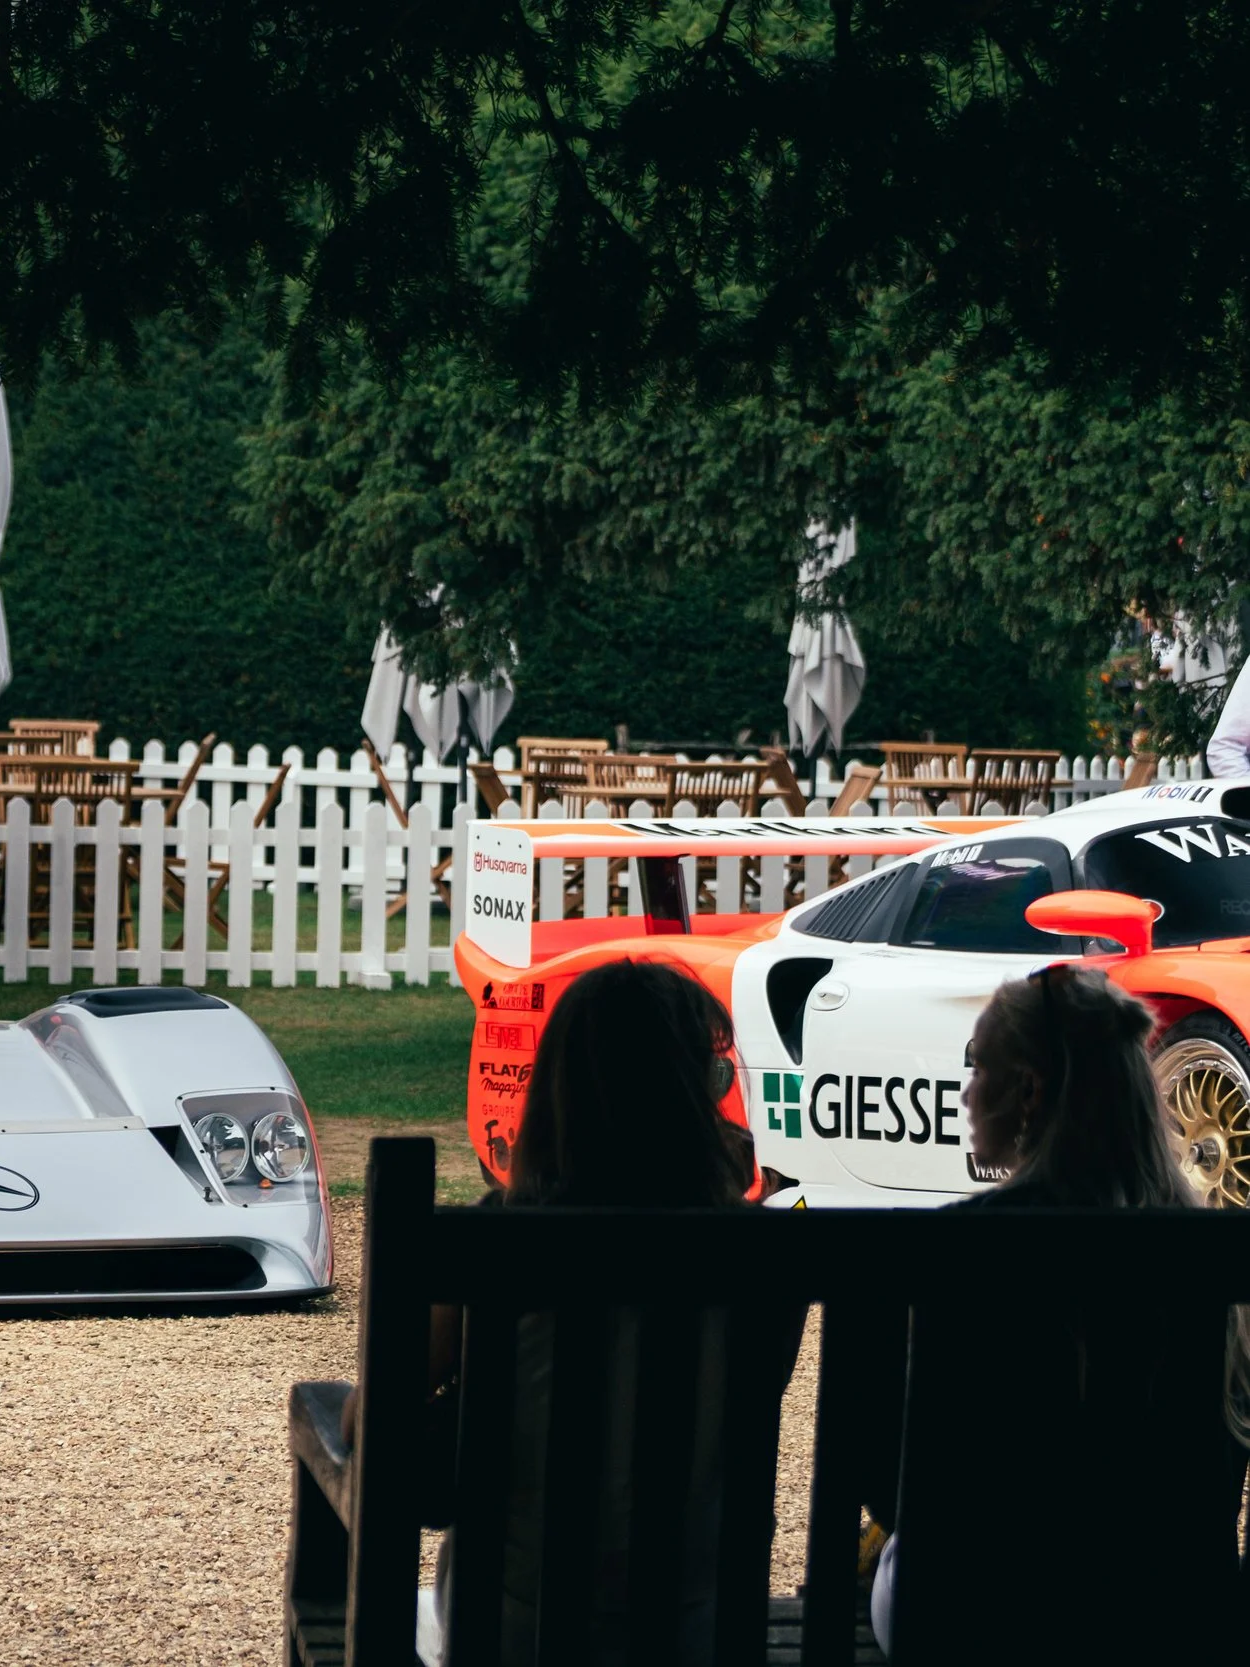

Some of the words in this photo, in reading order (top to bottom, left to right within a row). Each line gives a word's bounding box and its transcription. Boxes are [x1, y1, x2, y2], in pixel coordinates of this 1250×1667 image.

[1141, 785, 1194, 800] Mobil
[482, 854, 528, 876] Husqvarna
[930, 846, 971, 868] Mobil
[473, 894, 526, 922] SONAX
[808, 1073, 962, 1146] GIESSE
